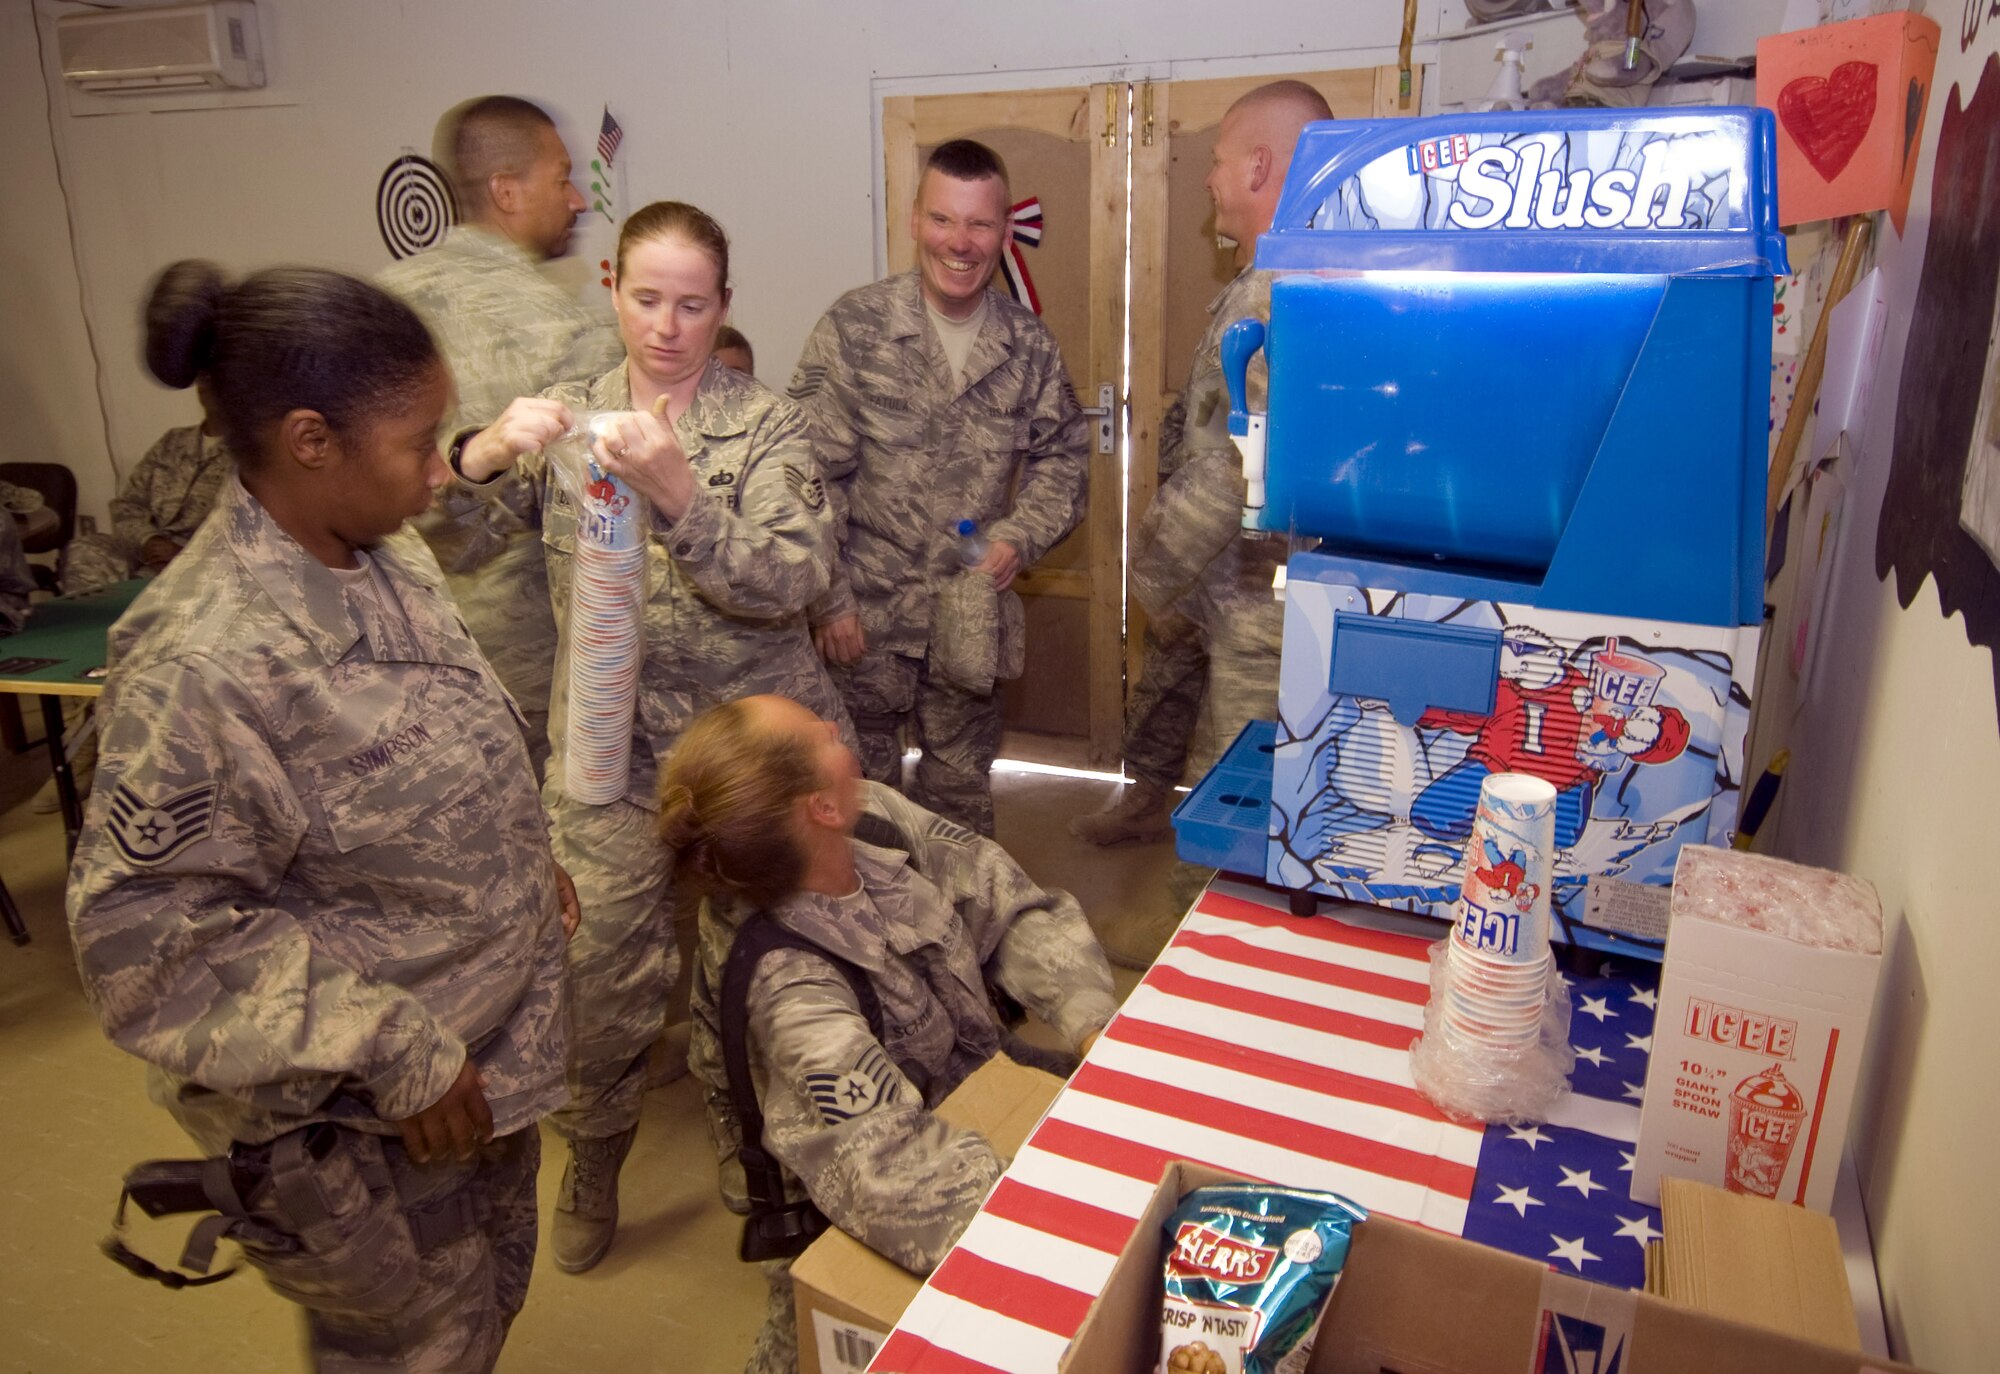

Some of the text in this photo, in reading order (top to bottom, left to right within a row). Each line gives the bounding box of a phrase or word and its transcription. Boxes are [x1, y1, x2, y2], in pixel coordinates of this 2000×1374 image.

[1409, 134, 1467, 174] ICEE
[1450, 141, 1691, 230] Slush
[348, 722, 432, 776] SIMPSON
[1687, 1000, 1796, 1059] ICEE
[1674, 1088, 1721, 1108] SPOON
[1675, 1077, 1719, 1095] GIANT
[1672, 1100, 1720, 1119] STRAW
[1739, 1108, 1796, 1144] ICEE
[1665, 1149, 1697, 1164] wrapped
[1242, 1211, 1286, 1224] Guaranteed
[1178, 1233, 1265, 1278] HERR'S
[1214, 1318, 1248, 1337] TASTY
